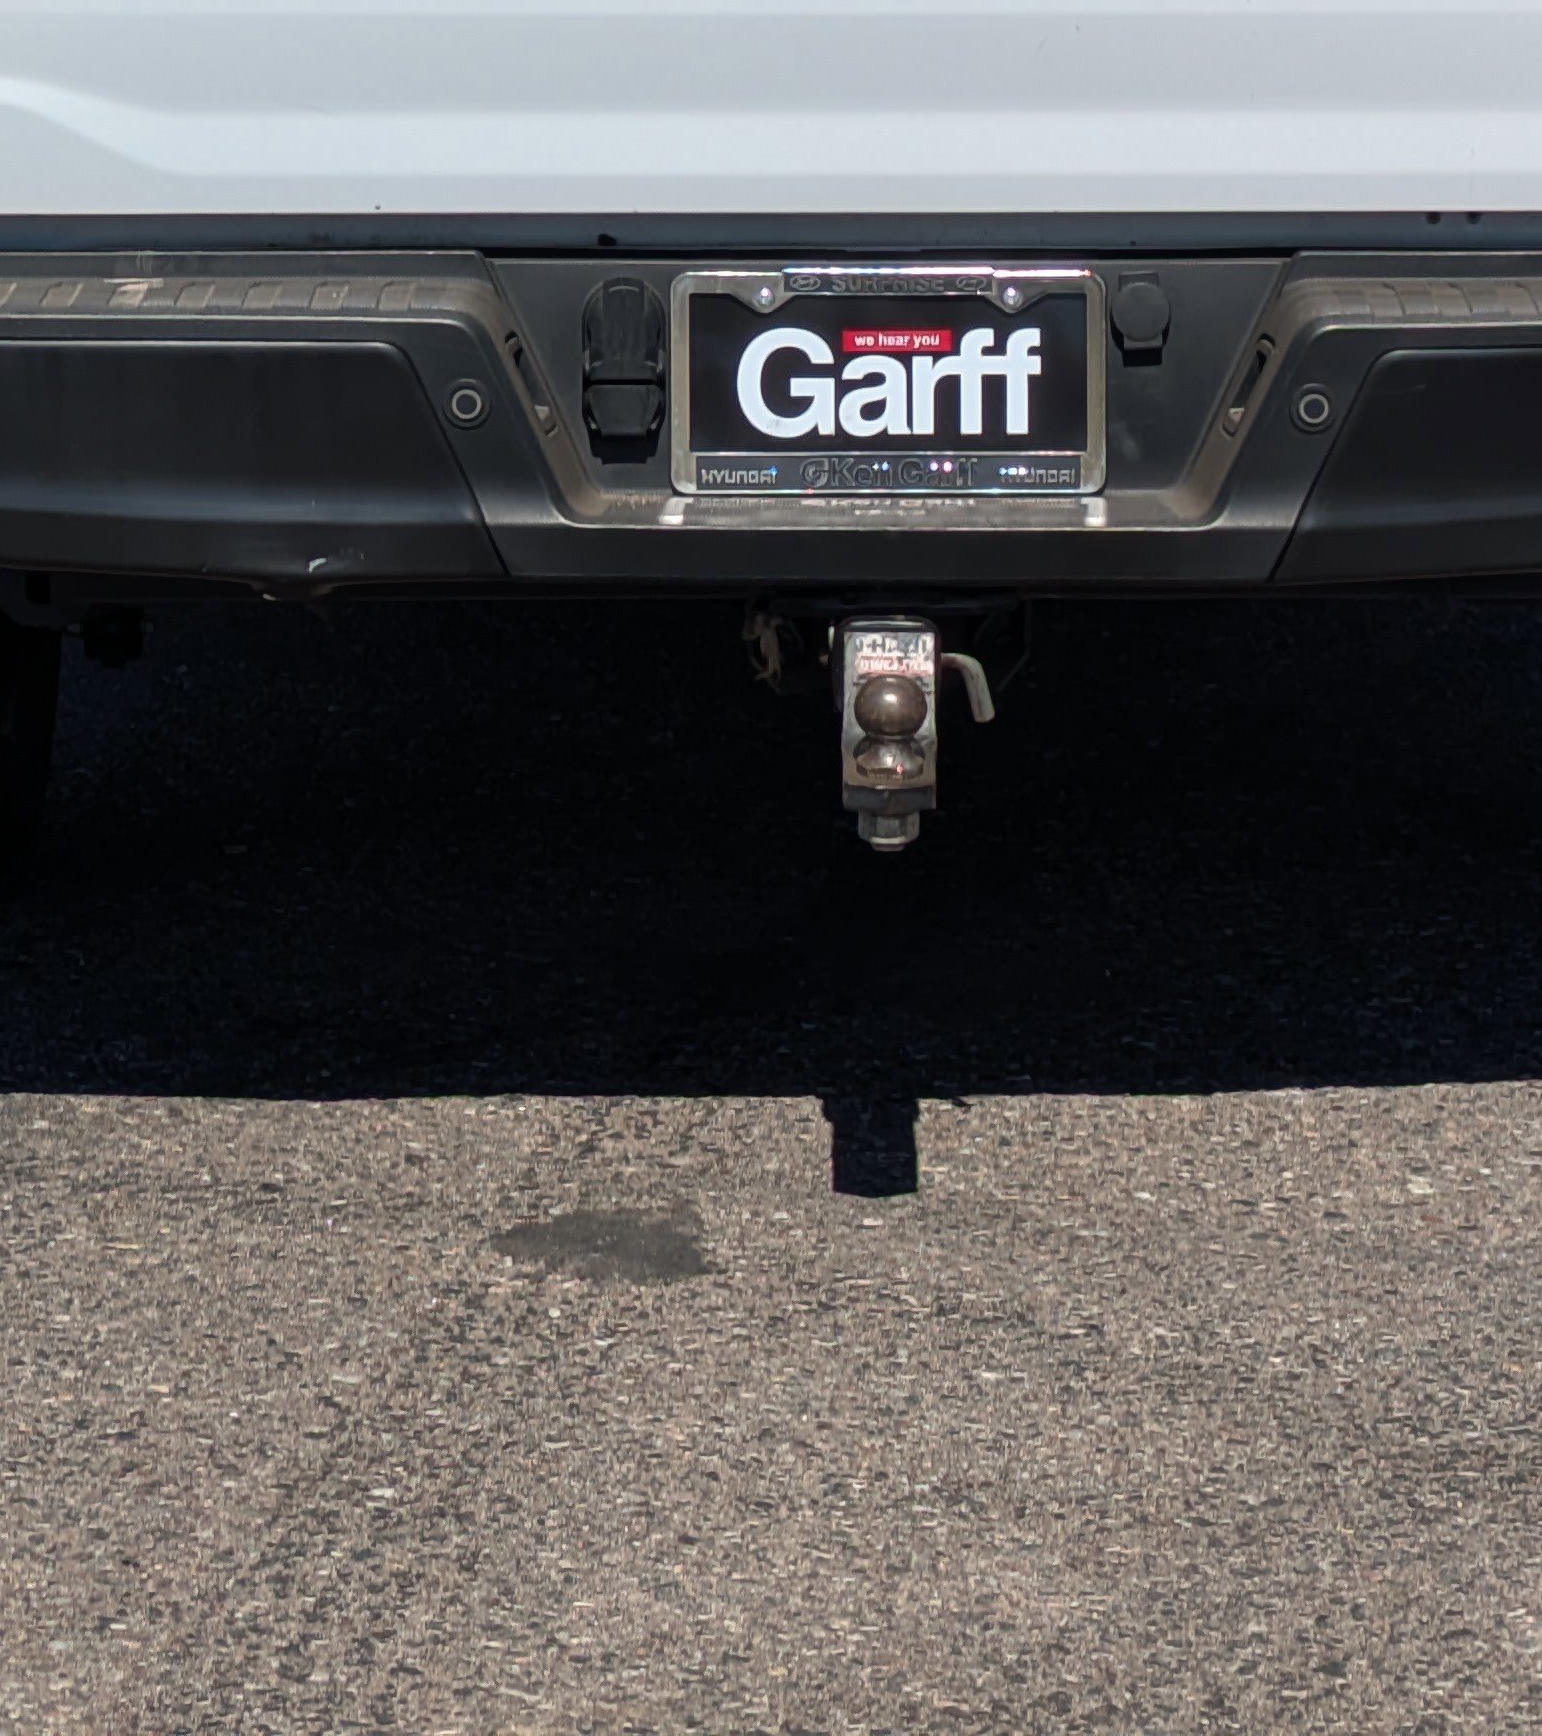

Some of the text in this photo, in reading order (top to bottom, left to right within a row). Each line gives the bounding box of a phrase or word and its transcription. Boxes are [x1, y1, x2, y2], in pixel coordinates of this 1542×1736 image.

[854, 332, 940, 349] we hear you
[736, 327, 1042, 439] Garff
[701, 467, 780, 485] HYUNDAI
[830, 457, 893, 487] Ken
